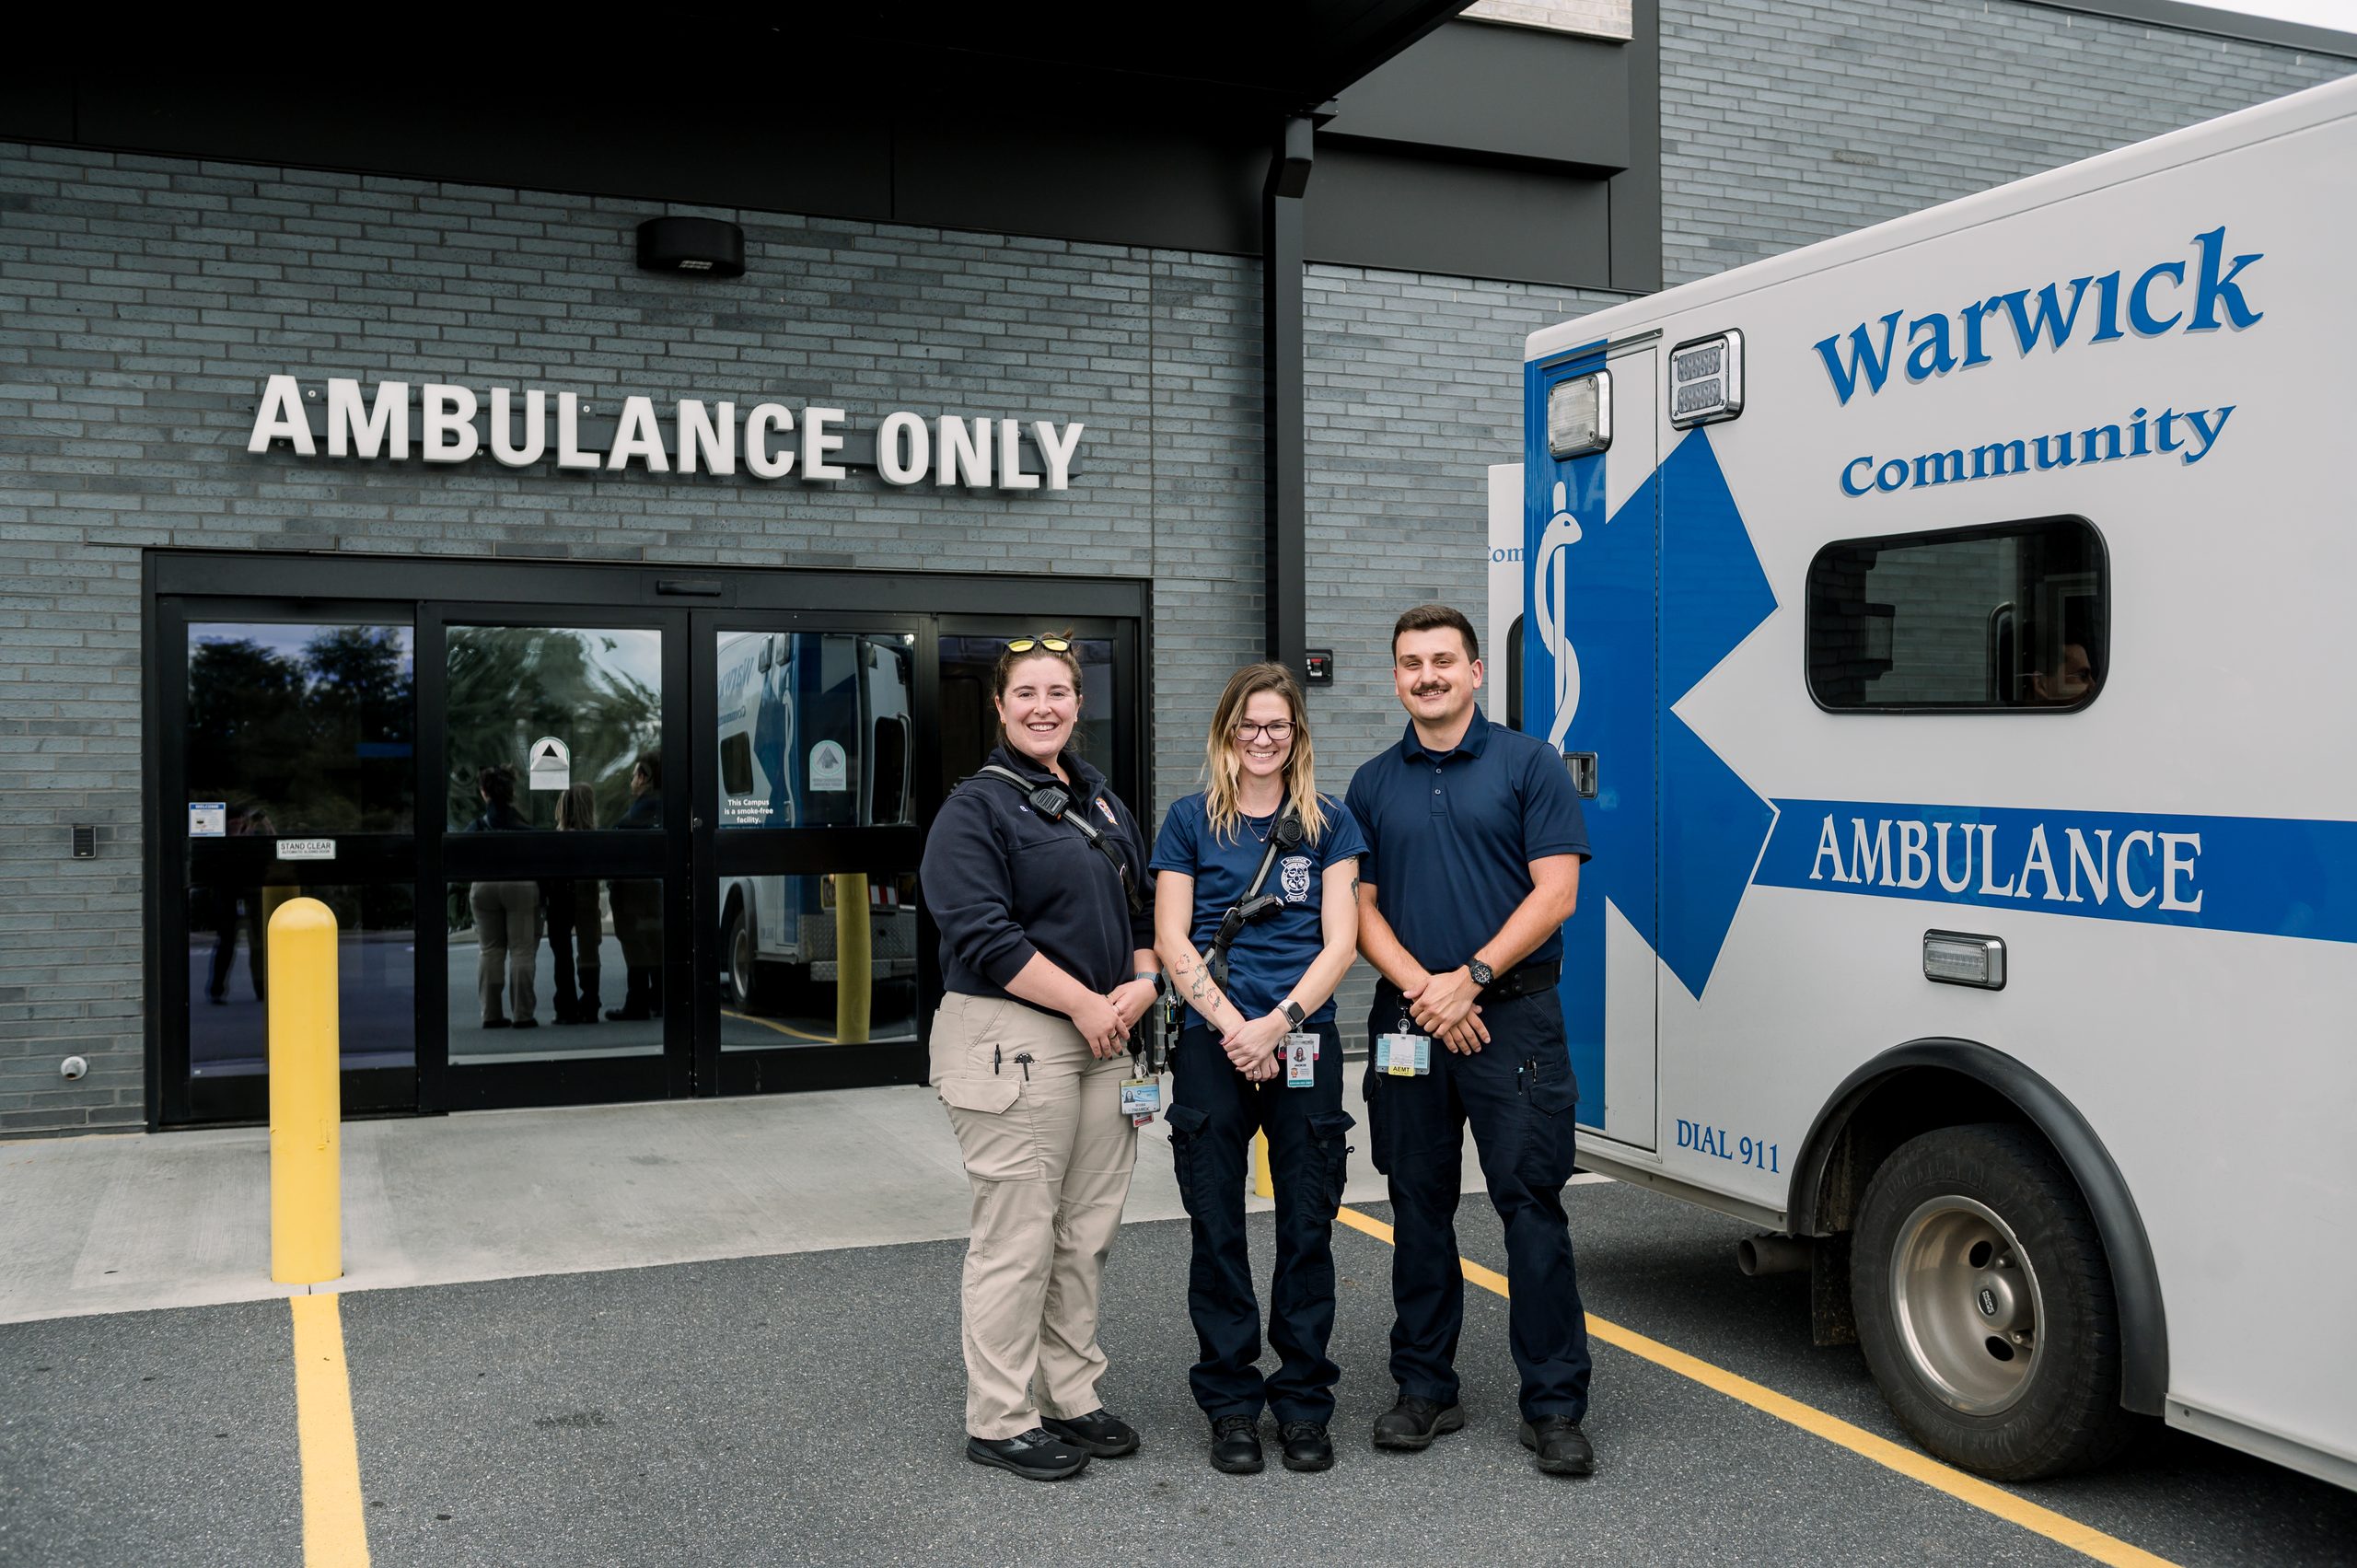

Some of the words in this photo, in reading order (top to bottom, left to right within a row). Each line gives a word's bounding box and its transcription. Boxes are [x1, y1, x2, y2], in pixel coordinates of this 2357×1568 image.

[1814, 226, 2264, 407] Warwick
[247, 373, 846, 482] AMBULANCE
[877, 411, 1086, 492] ONLY
[1840, 404, 2236, 497] Community
[1488, 546, 1524, 563] om
[727, 798, 742, 807] This
[743, 798, 770, 807] Campus
[737, 816, 761, 825] facility.
[280, 842, 305, 851] STAND
[307, 842, 331, 850] CLEAR
[1809, 813, 2203, 914] AMBULANCE
[1677, 1119, 1733, 1160] DIAL
[1738, 1136, 1779, 1173] 911
